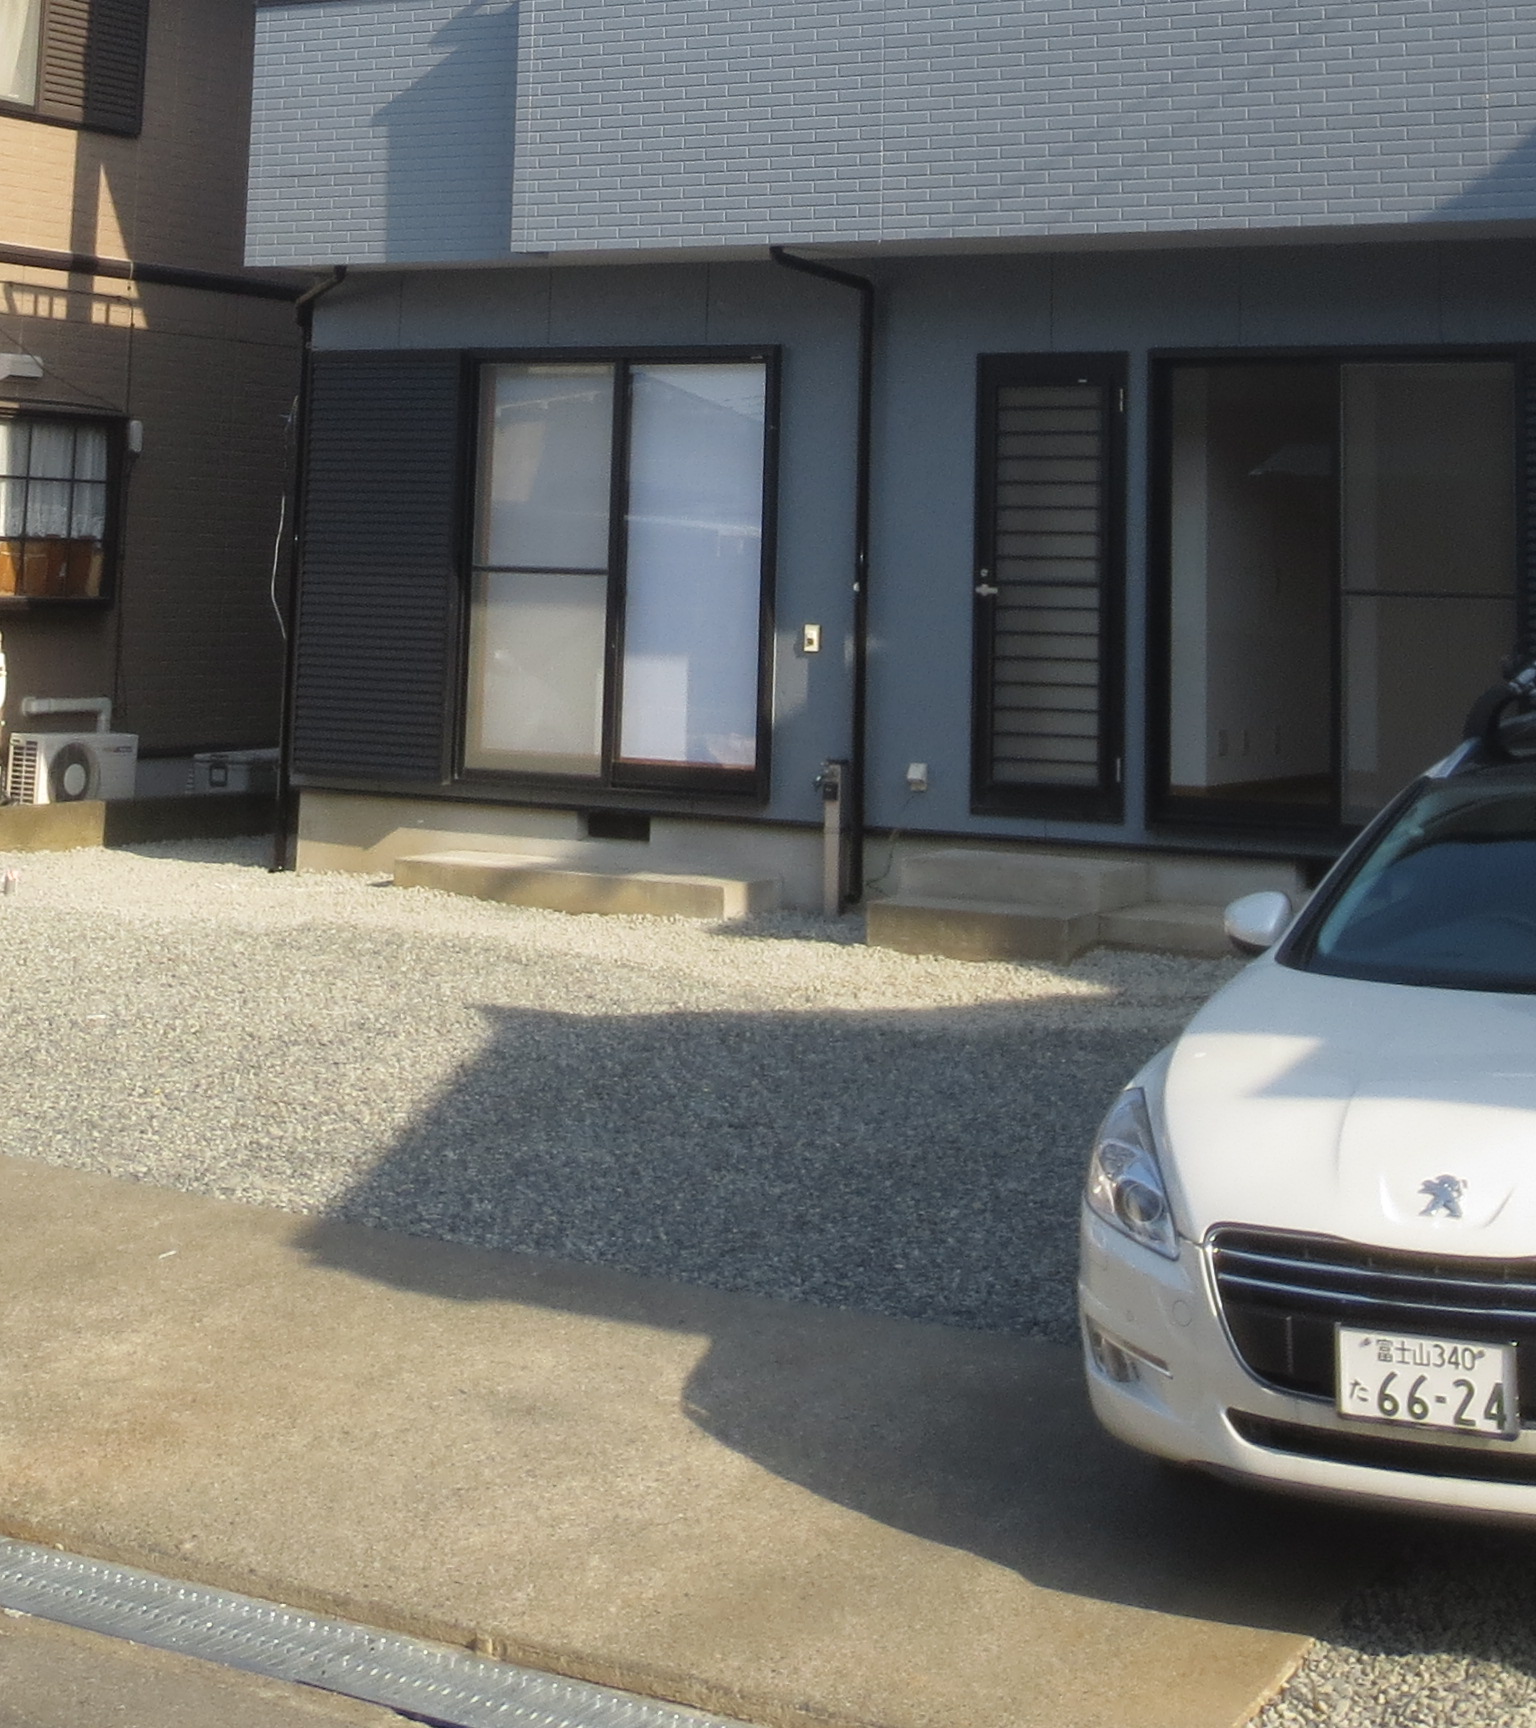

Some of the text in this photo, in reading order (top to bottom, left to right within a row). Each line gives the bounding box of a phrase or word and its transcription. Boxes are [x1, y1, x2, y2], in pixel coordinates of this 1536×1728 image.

[1376, 1338, 1475, 1371] 富士山340
[1349, 1371, 1507, 1431] た 66-24
